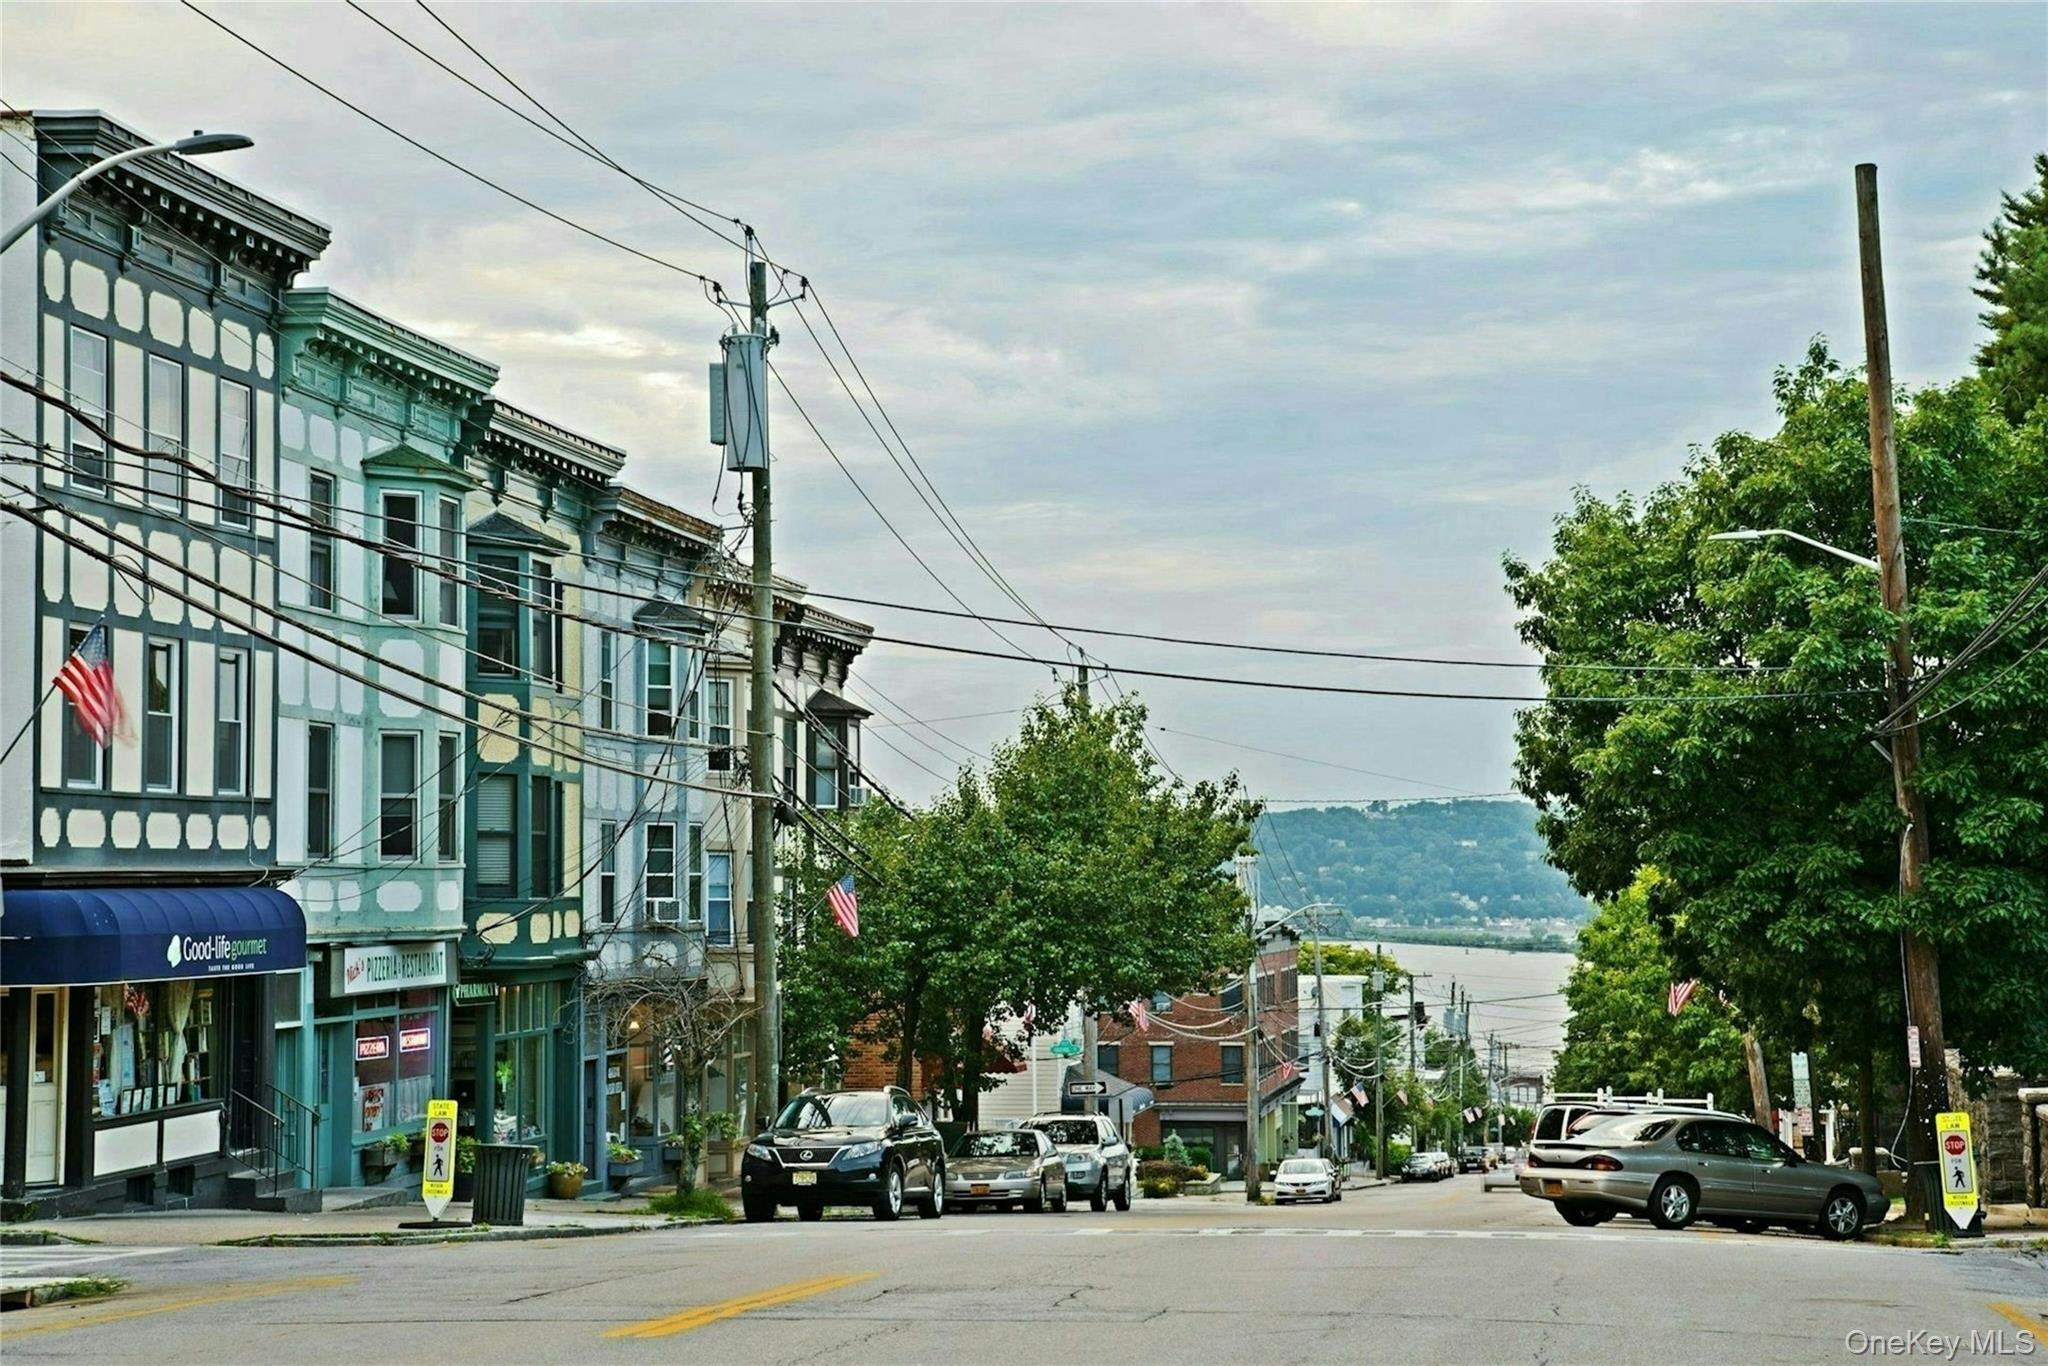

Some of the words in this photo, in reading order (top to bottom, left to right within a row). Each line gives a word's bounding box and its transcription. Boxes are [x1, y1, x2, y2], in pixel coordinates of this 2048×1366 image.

[183, 935, 231, 961] Good-life
[231, 938, 267, 961] gourmet
[231, 963, 244, 971] GOOD
[367, 954, 398, 982] PIZZERIA
[402, 951, 443, 979] RESTAURANT
[431, 1128, 449, 1137] STOP
[1946, 1140, 1965, 1150] STOP
